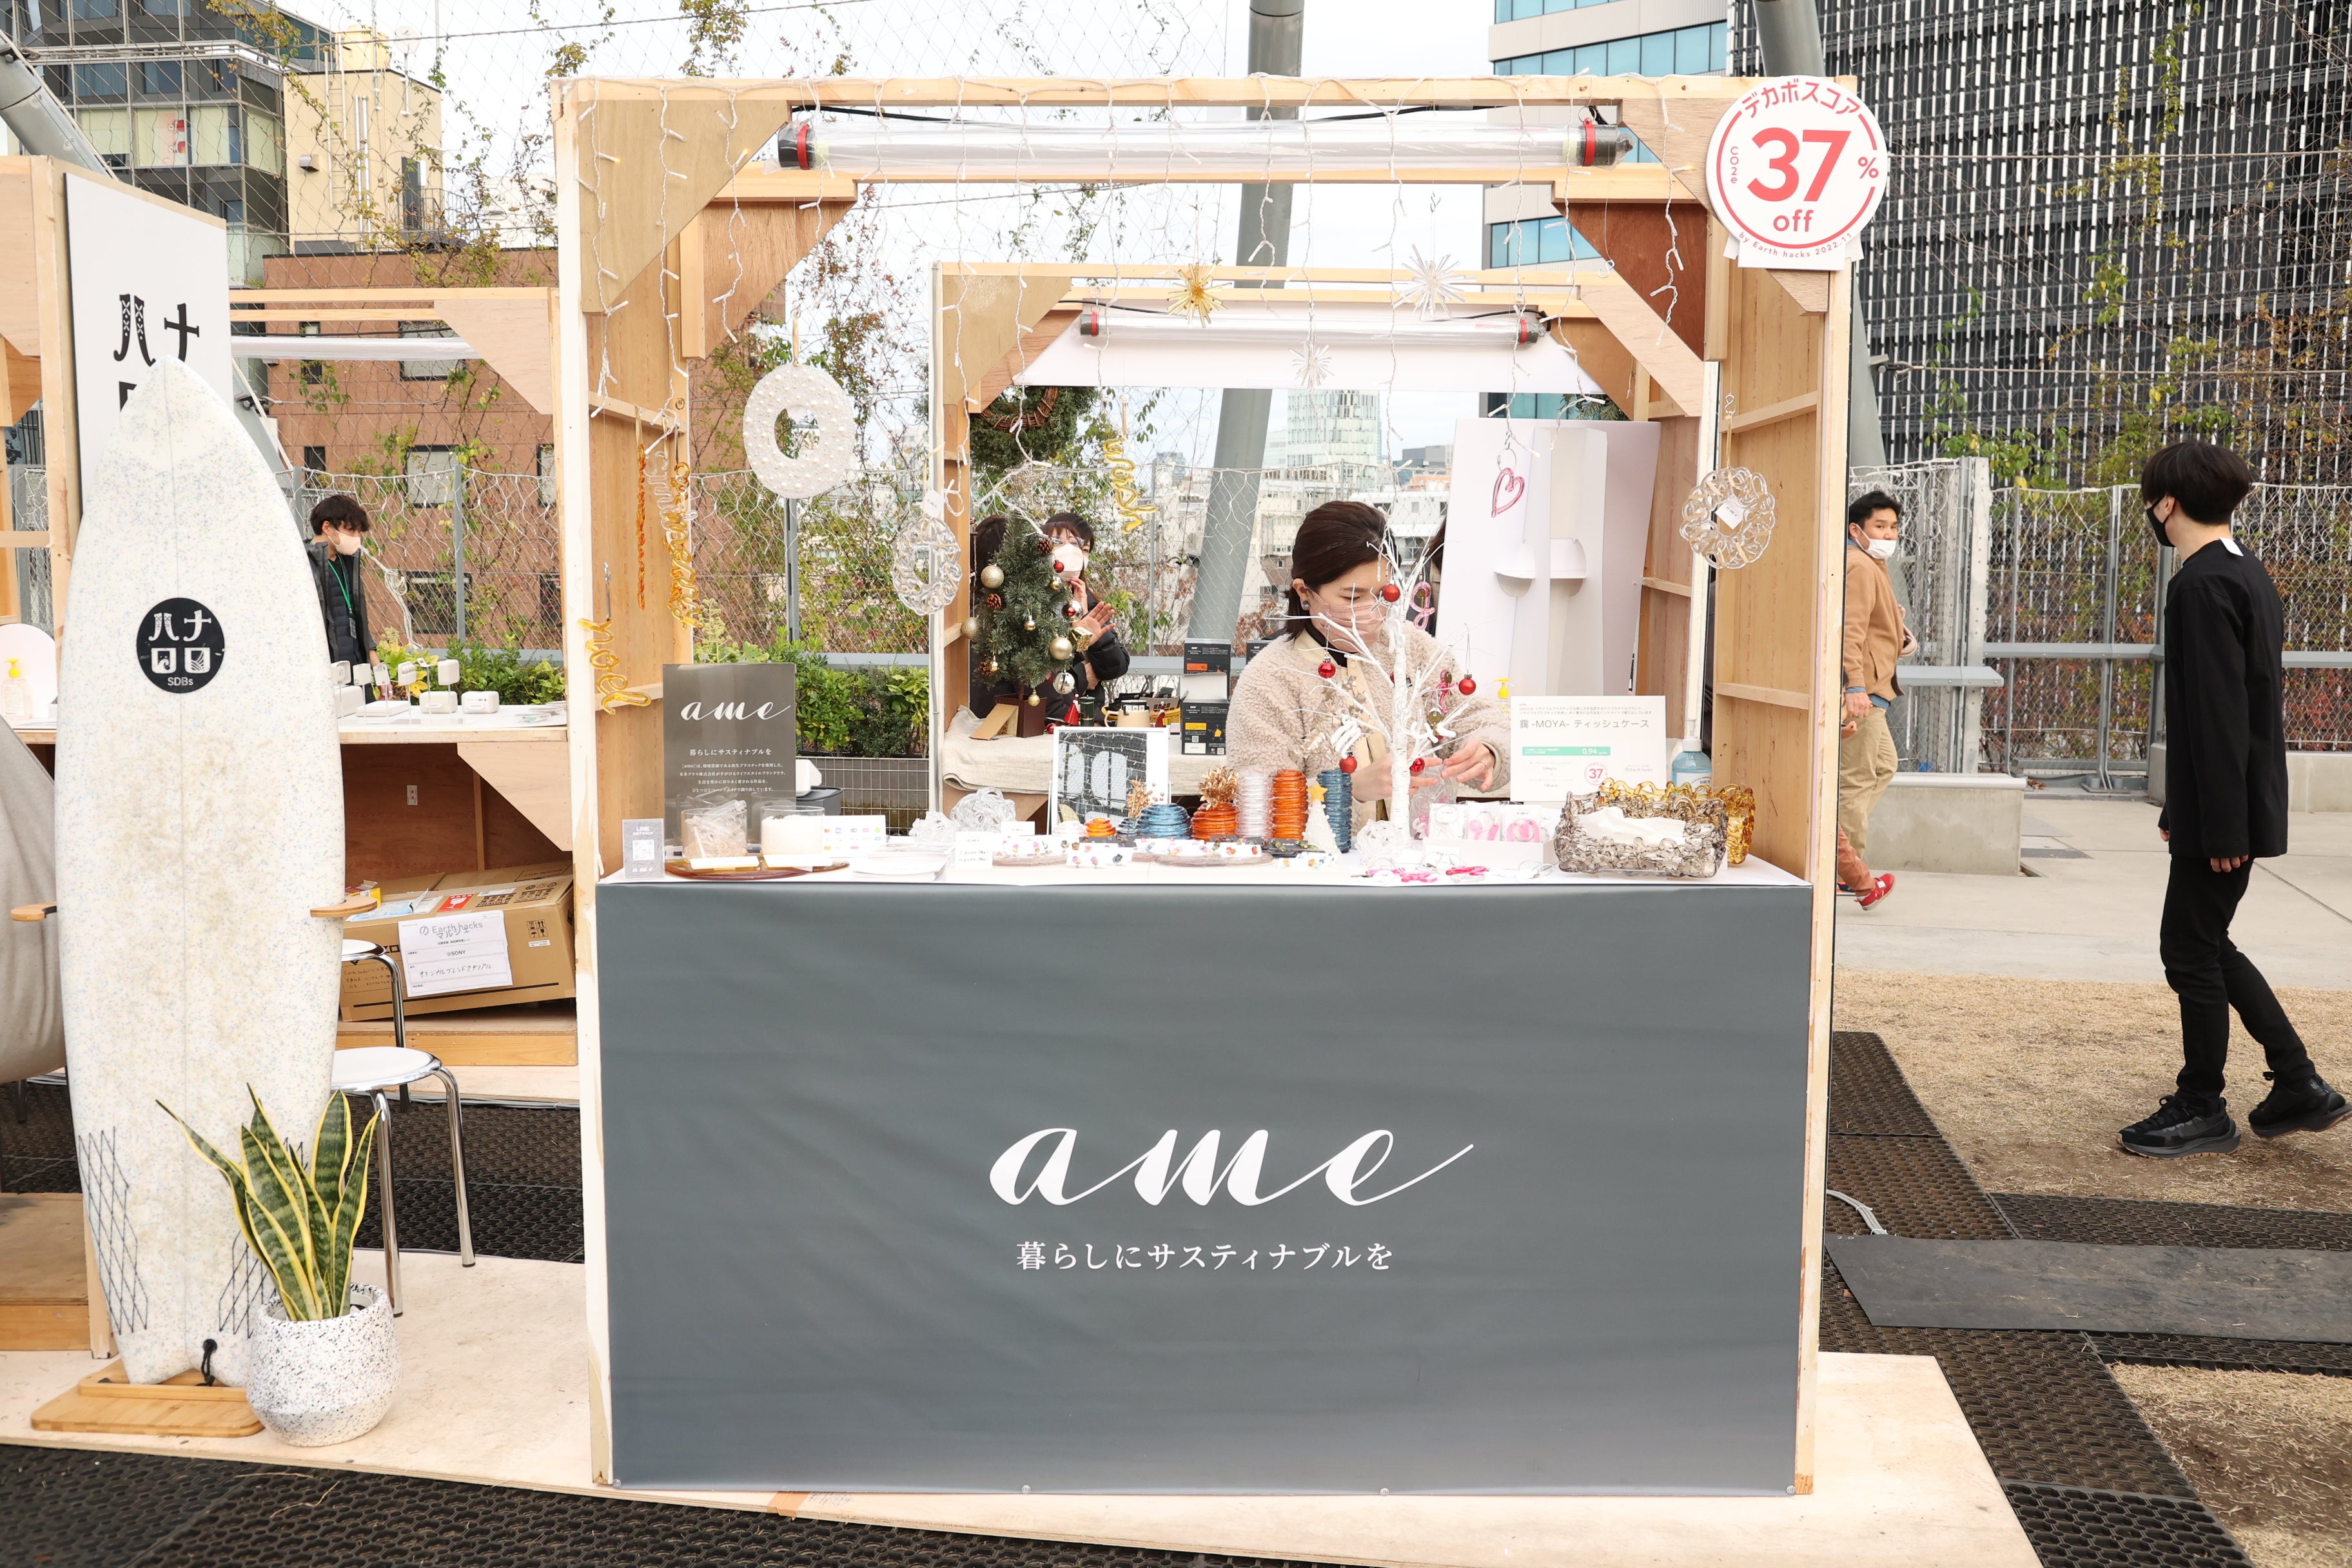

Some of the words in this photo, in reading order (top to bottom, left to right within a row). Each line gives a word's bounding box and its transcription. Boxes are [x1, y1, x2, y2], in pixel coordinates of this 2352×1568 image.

[1742, 78, 1861, 118] デカボスコア
[1747, 127, 1852, 202] 37
[1857, 157, 1879, 179] %
[1773, 209, 1814, 232] off
[1739, 231, 1749, 243] by
[1752, 240, 1778, 256] Earth
[1783, 249, 1810, 258] hacks
[1816, 232, 1852, 255] 2022.11
[167, 676, 194, 687] SDBs
[680, 701, 792, 721] ame
[1574, 720, 1649, 728] ティッシュケース
[1589, 769, 1603, 779] 37
[433, 923, 456, 934] Earth
[458, 920, 484, 931] hacks
[989, 1128, 1475, 1206] ame
[1016, 1241, 1393, 1271] 暮らしにサスティナブルを
